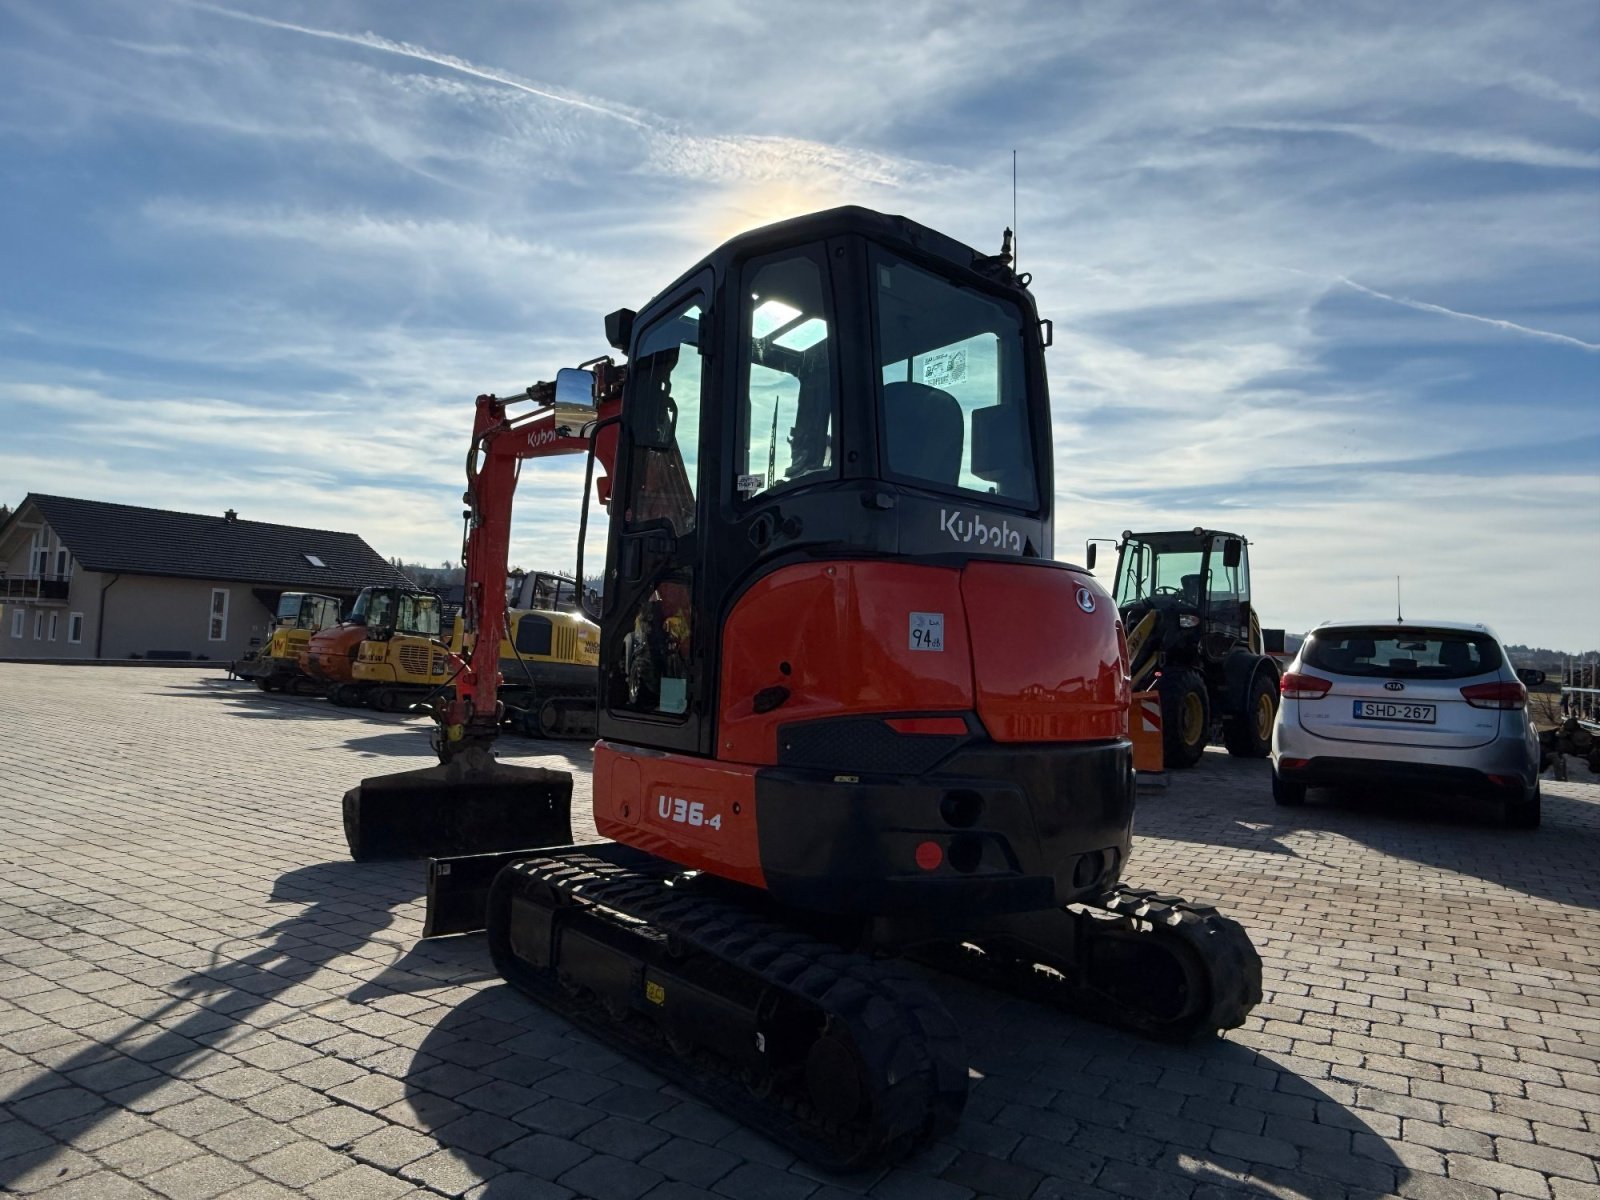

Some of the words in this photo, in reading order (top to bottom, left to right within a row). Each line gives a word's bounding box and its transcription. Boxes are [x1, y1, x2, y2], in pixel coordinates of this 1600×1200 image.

[527, 429, 563, 448] Kubot
[940, 509, 1021, 552] Kubota
[912, 629, 931, 647] 94
[1365, 704, 1431, 720] SHD-267
